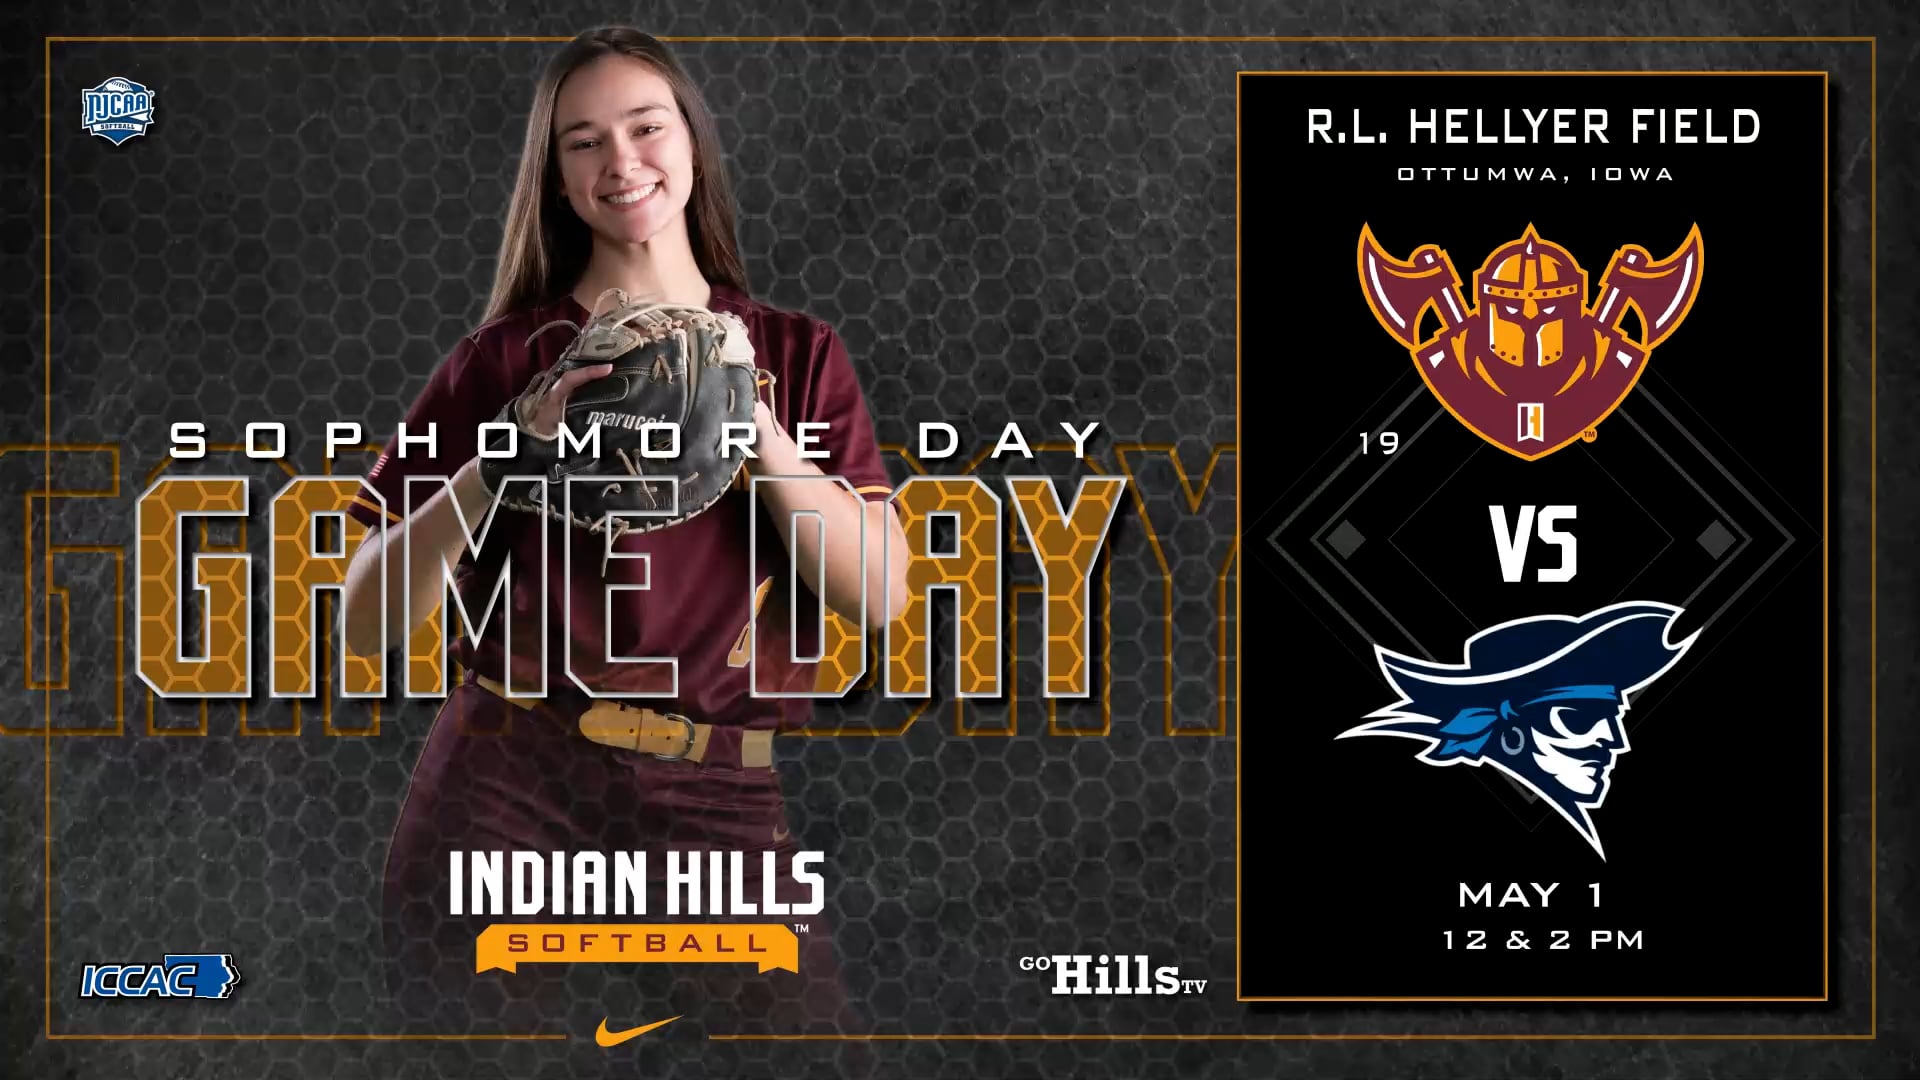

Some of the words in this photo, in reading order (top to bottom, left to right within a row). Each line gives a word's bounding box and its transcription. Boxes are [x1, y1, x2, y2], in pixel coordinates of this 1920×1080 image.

[1308, 108, 1387, 144] R.L.
[1410, 108, 1610, 144] HELLYER
[1632, 108, 1760, 144] FIELD
[1397, 167, 1569, 184] OTTUMWA,
[1591, 167, 1673, 181] IOWA
[169, 422, 832, 459] SOPHOMORE
[919, 422, 1100, 459] DAY
[1359, 431, 1399, 455] 19
[1488, 505, 1577, 583] VS
[135, 475, 680, 699] GAME
[749, 475, 1128, 699] DAY
[450, 850, 647, 915] INDIAN
[666, 850, 825, 915] HILLS
[1459, 882, 1560, 908] MAY
[1588, 882, 1601, 908] 1
[507, 933, 768, 954] SOFTBALL
[1443, 930, 1487, 950] 12
[1506, 930, 1531, 950] &
[1549, 930, 1571, 950] 2
[1591, 930, 1643, 950] PM
[81, 965, 196, 997] ICCAC
